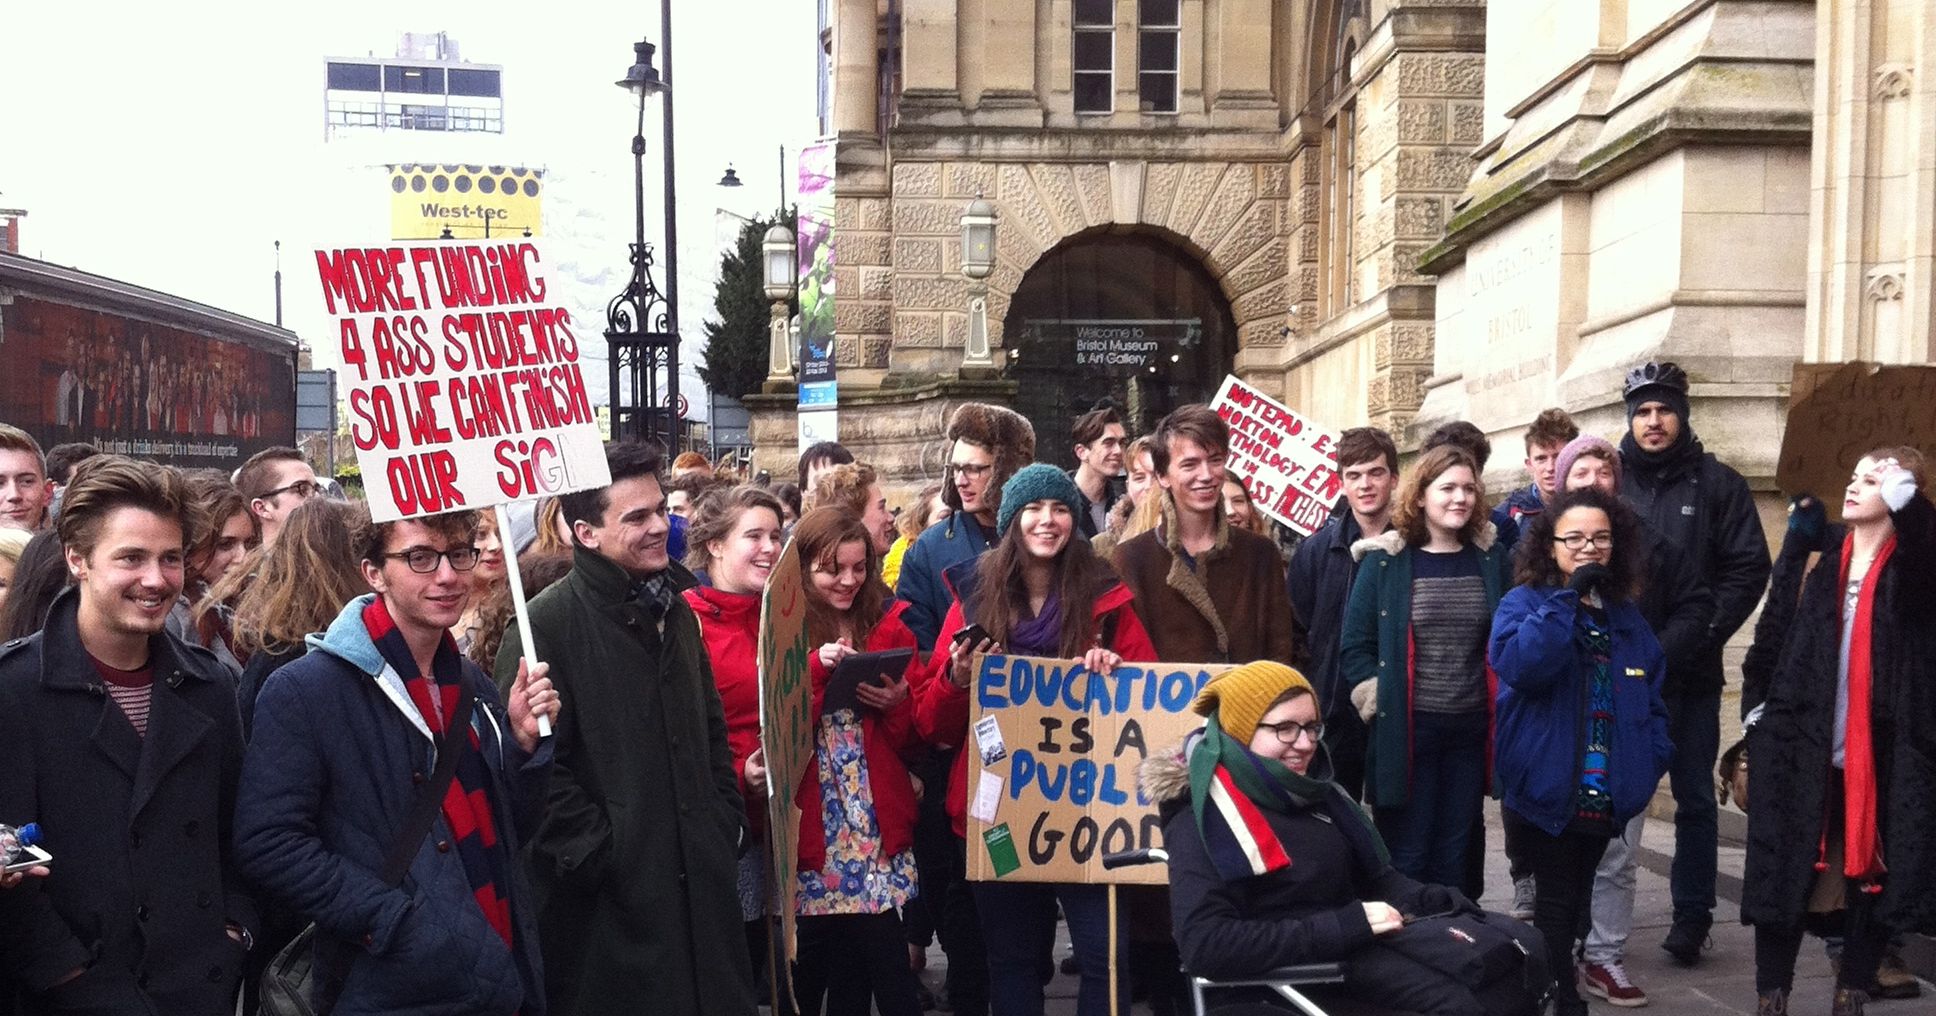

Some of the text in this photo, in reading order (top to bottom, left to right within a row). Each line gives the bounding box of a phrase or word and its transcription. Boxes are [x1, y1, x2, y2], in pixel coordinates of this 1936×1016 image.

[421, 203, 508, 220] West-tec
[315, 247, 417, 314] MORE
[340, 307, 579, 381] 4 ASS STUDENTS
[1076, 327, 1144, 339] Welcome to
[1076, 339, 1158, 351] Bristol Museum
[1488, 304, 1532, 345] BRISTOL
[1076, 352, 1147, 366] & Art Gallery
[350, 385, 400, 451] SO
[400, 381, 453, 447] WE
[449, 371, 511, 440] CAN
[386, 449, 466, 516] OUR
[1038, 717, 1094, 753] IS
[1114, 718, 1147, 759] A
[1010, 749, 1151, 806] PUBL
